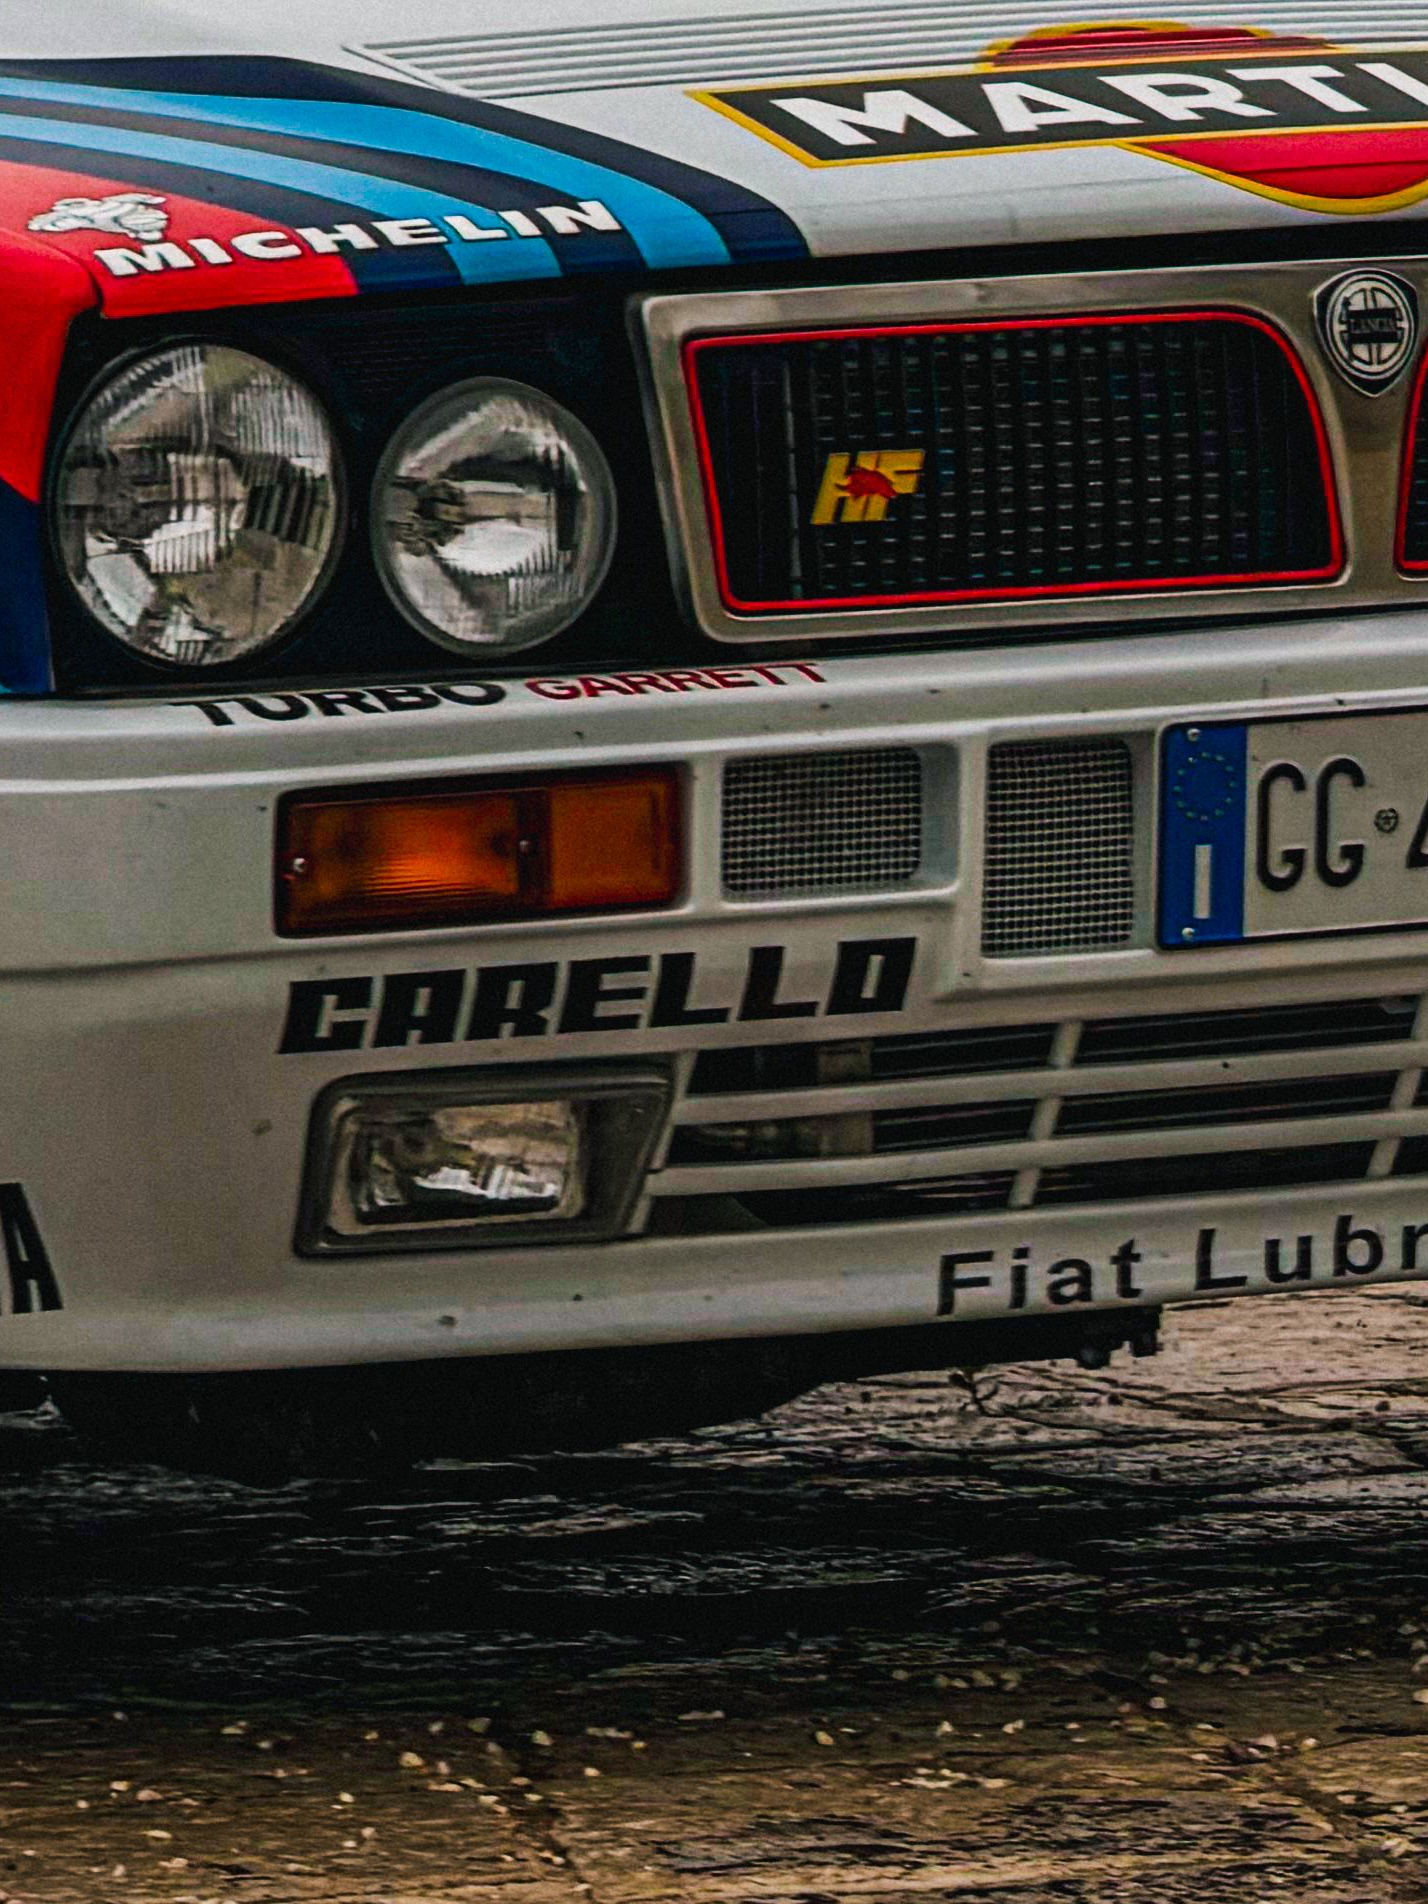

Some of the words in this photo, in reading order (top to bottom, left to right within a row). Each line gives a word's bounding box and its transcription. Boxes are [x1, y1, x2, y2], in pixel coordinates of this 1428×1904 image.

[94, 200, 625, 276] MICHELIN
[811, 448, 925, 525] HF
[172, 681, 507, 726] TURBO
[525, 662, 828, 700] GARRETT
[1256, 757, 1366, 894] GG
[276, 937, 916, 1055] CARELLO
[936, 1239, 1143, 1316] Fiat
